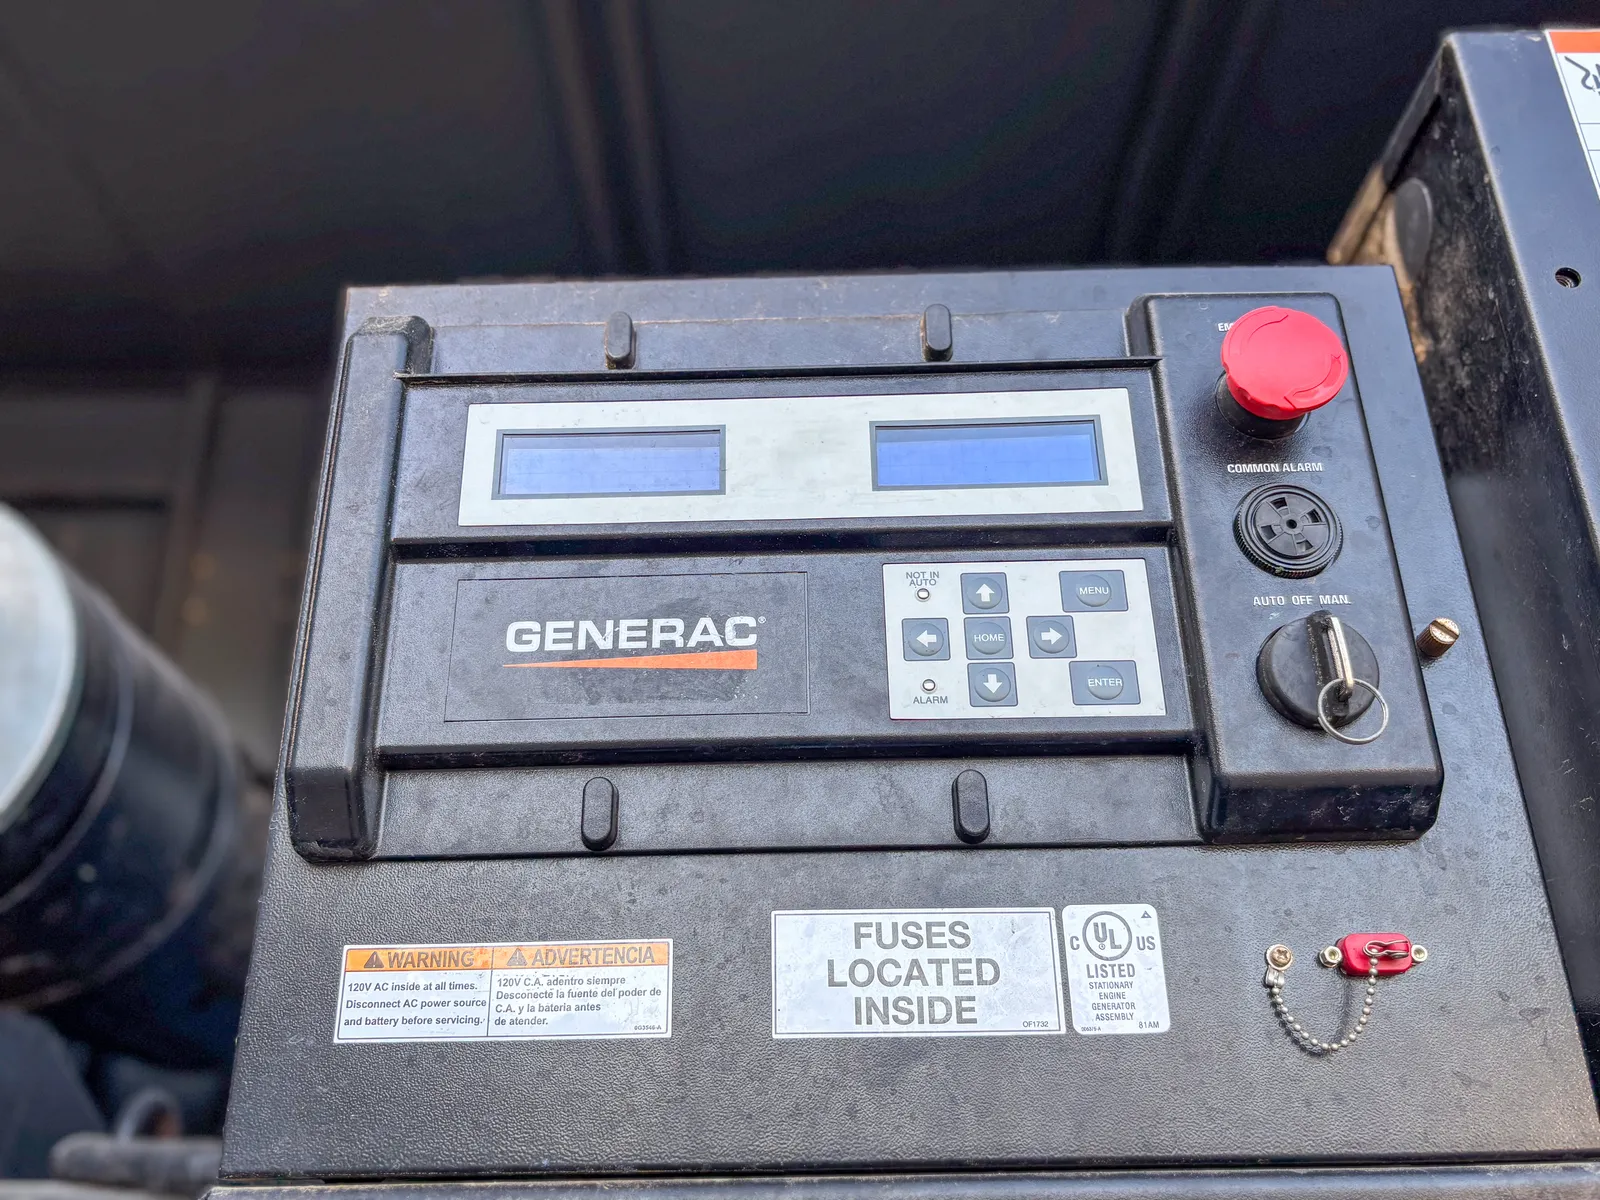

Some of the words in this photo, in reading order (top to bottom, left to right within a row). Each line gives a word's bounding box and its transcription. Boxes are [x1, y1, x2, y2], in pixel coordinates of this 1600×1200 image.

[1228, 464, 1280, 473] COMMON
[1282, 463, 1322, 472] ALARM
[929, 571, 940, 579] IN
[1079, 586, 1109, 595] MENU
[1253, 596, 1284, 606] AUTO
[1292, 596, 1313, 605] OFF
[974, 634, 1004, 642] HOME
[1088, 678, 1122, 687] ENTER
[913, 696, 948, 704] ALARM
[854, 921, 971, 950] FUSES
[1070, 936, 1080, 950] C
[1136, 936, 1156, 950] US
[387, 950, 474, 968] WARNING
[532, 946, 655, 965] ADVERTENCIA
[827, 958, 1001, 988] LOCATED
[1086, 964, 1135, 978] LISTED
[348, 982, 372, 992] 120V
[374, 982, 389, 991] AC
[392, 982, 420, 991] inside
[423, 982, 432, 990] at
[435, 982, 446, 990] all
[449, 981, 478, 990] times.
[497, 978, 521, 987] 120V
[524, 977, 544, 986] C.A.
[547, 976, 584, 986] adentro
[587, 976, 626, 987] siempre
[1088, 981, 1133, 990] STATIONARY
[496, 990, 553, 999] Desconecte
[556, 989, 565, 998] la
[568, 989, 598, 998] fuente
[601, 988, 615, 997] del
[618, 988, 647, 999] poder
[650, 987, 661, 996] de
[1099, 992, 1126, 1000] ENGINE
[346, 999, 401, 1009] Disconnect
[403, 999, 418, 1008] AC
[420, 1000, 451, 1009] power
[495, 1004, 516, 1013] C.A.
[518, 1005, 524, 1015] y
[527, 1003, 536, 1012] la
[538, 1003, 572, 1012] bateria
[574, 1003, 601, 1011] antes
[1092, 1002, 1136, 1010] GENERATOR
[854, 996, 978, 1026] INSIDE
[344, 1017, 362, 1026] and
[365, 1016, 399, 1027] battery
[402, 1016, 433, 1025] before
[436, 1015, 483, 1026] servicing.
[495, 1017, 506, 1026] de
[509, 1016, 548, 1025] atender.
[1095, 1013, 1134, 1021] ASSEMBLY
